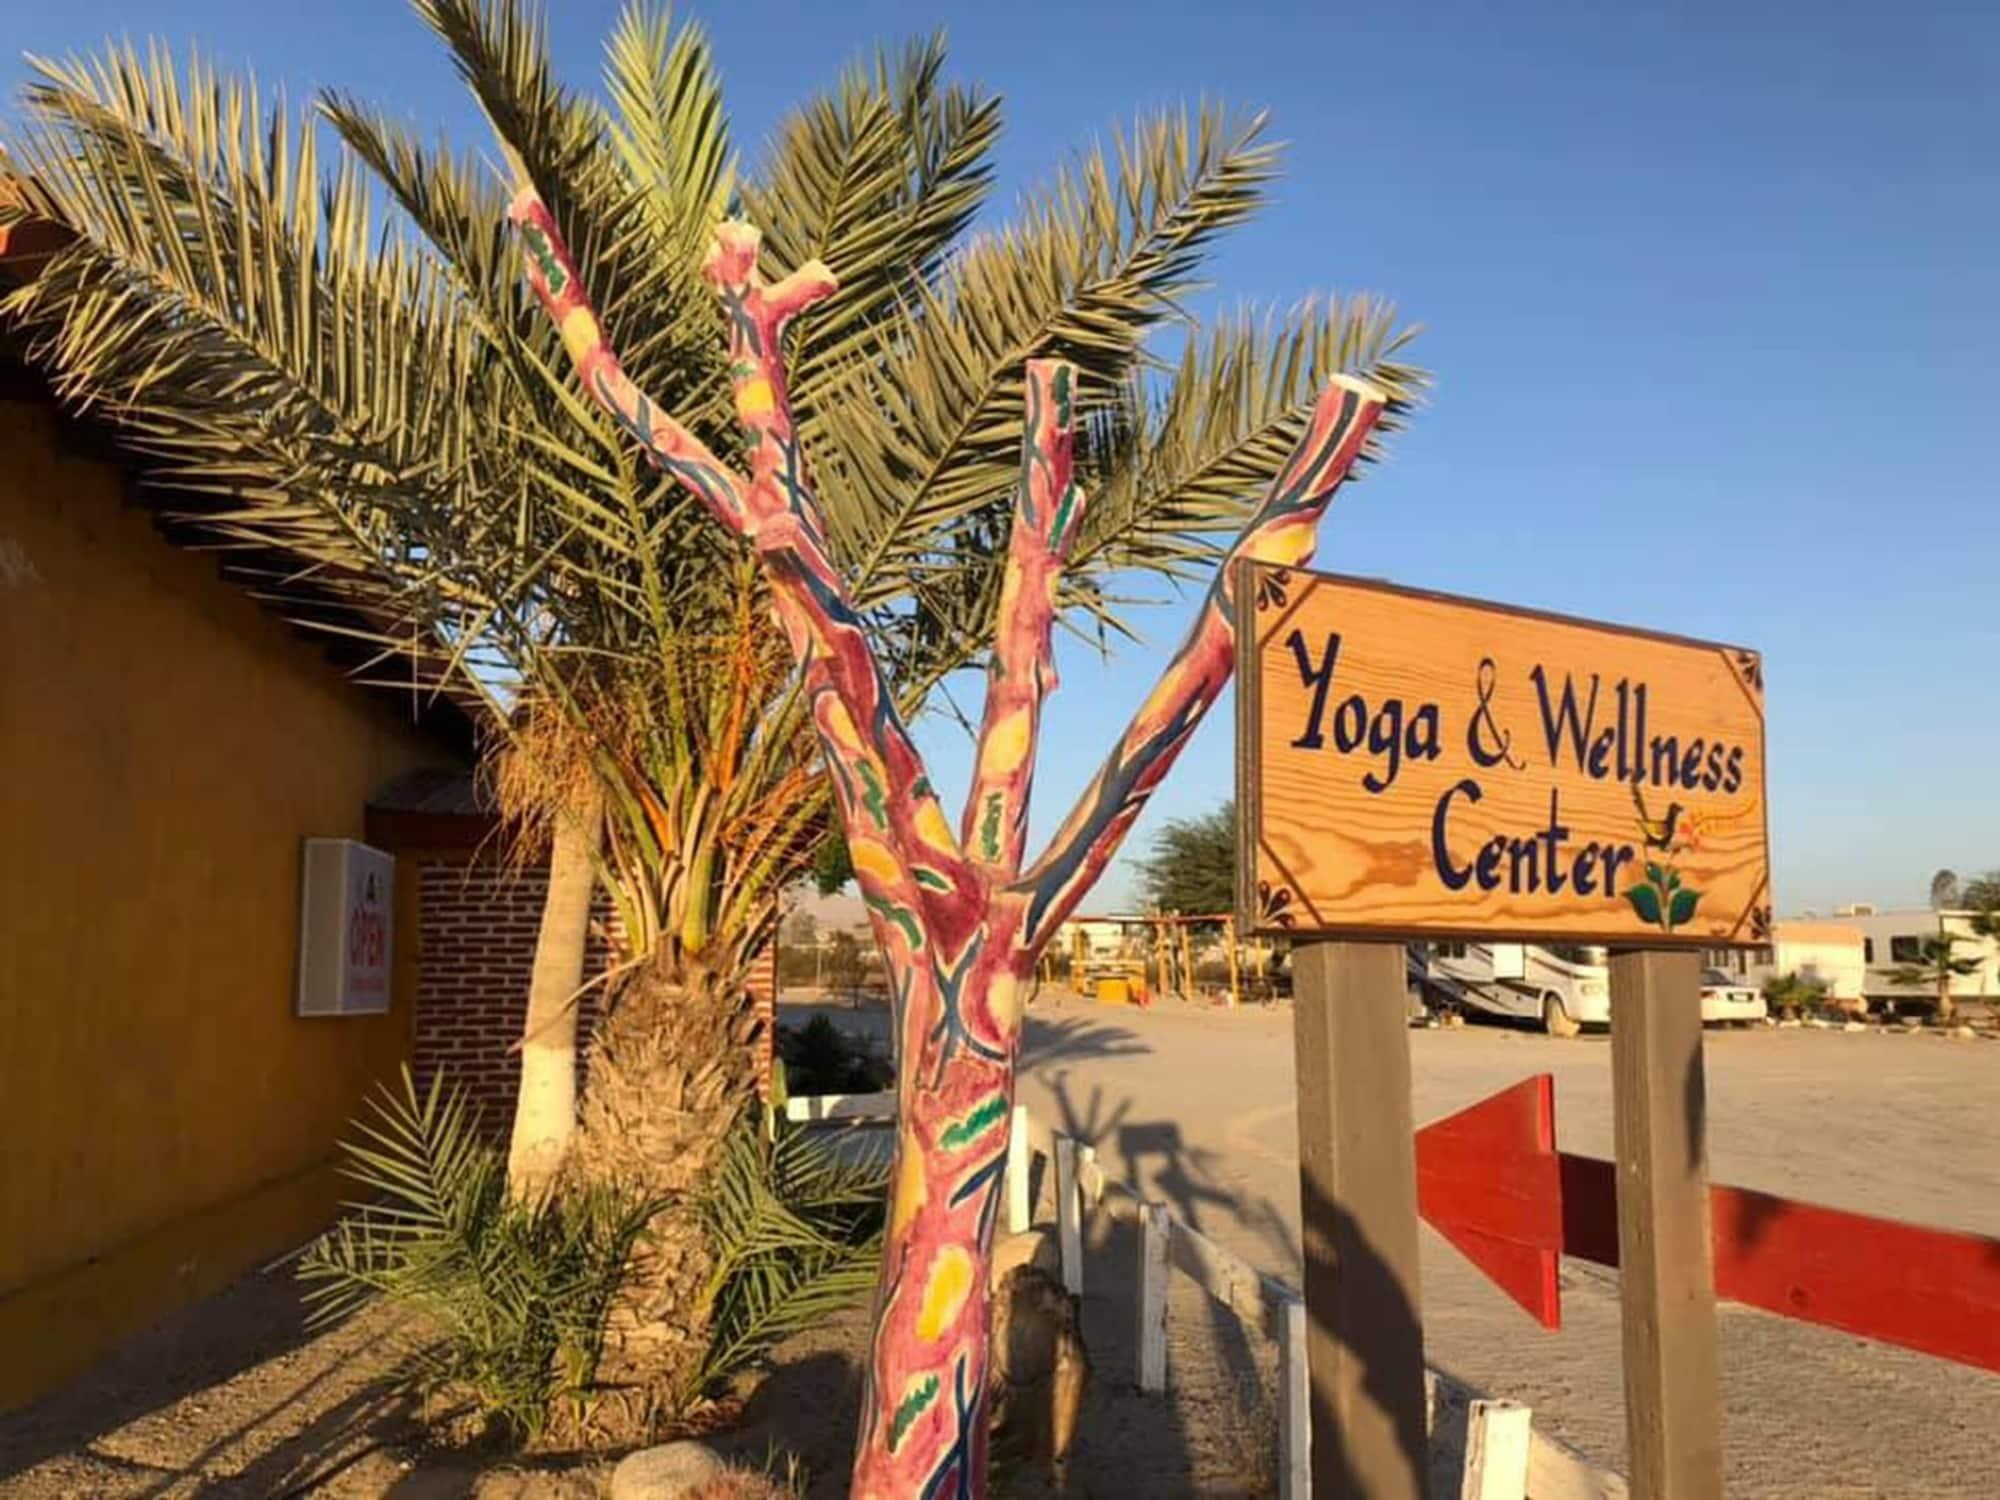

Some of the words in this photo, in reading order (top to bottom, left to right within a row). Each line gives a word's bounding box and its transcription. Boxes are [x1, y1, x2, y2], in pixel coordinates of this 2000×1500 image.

[1285, 629, 1441, 794] Yoga
[1466, 657, 1527, 770] &
[1529, 664, 1743, 794] Wellness
[1432, 779, 1635, 898] Center
